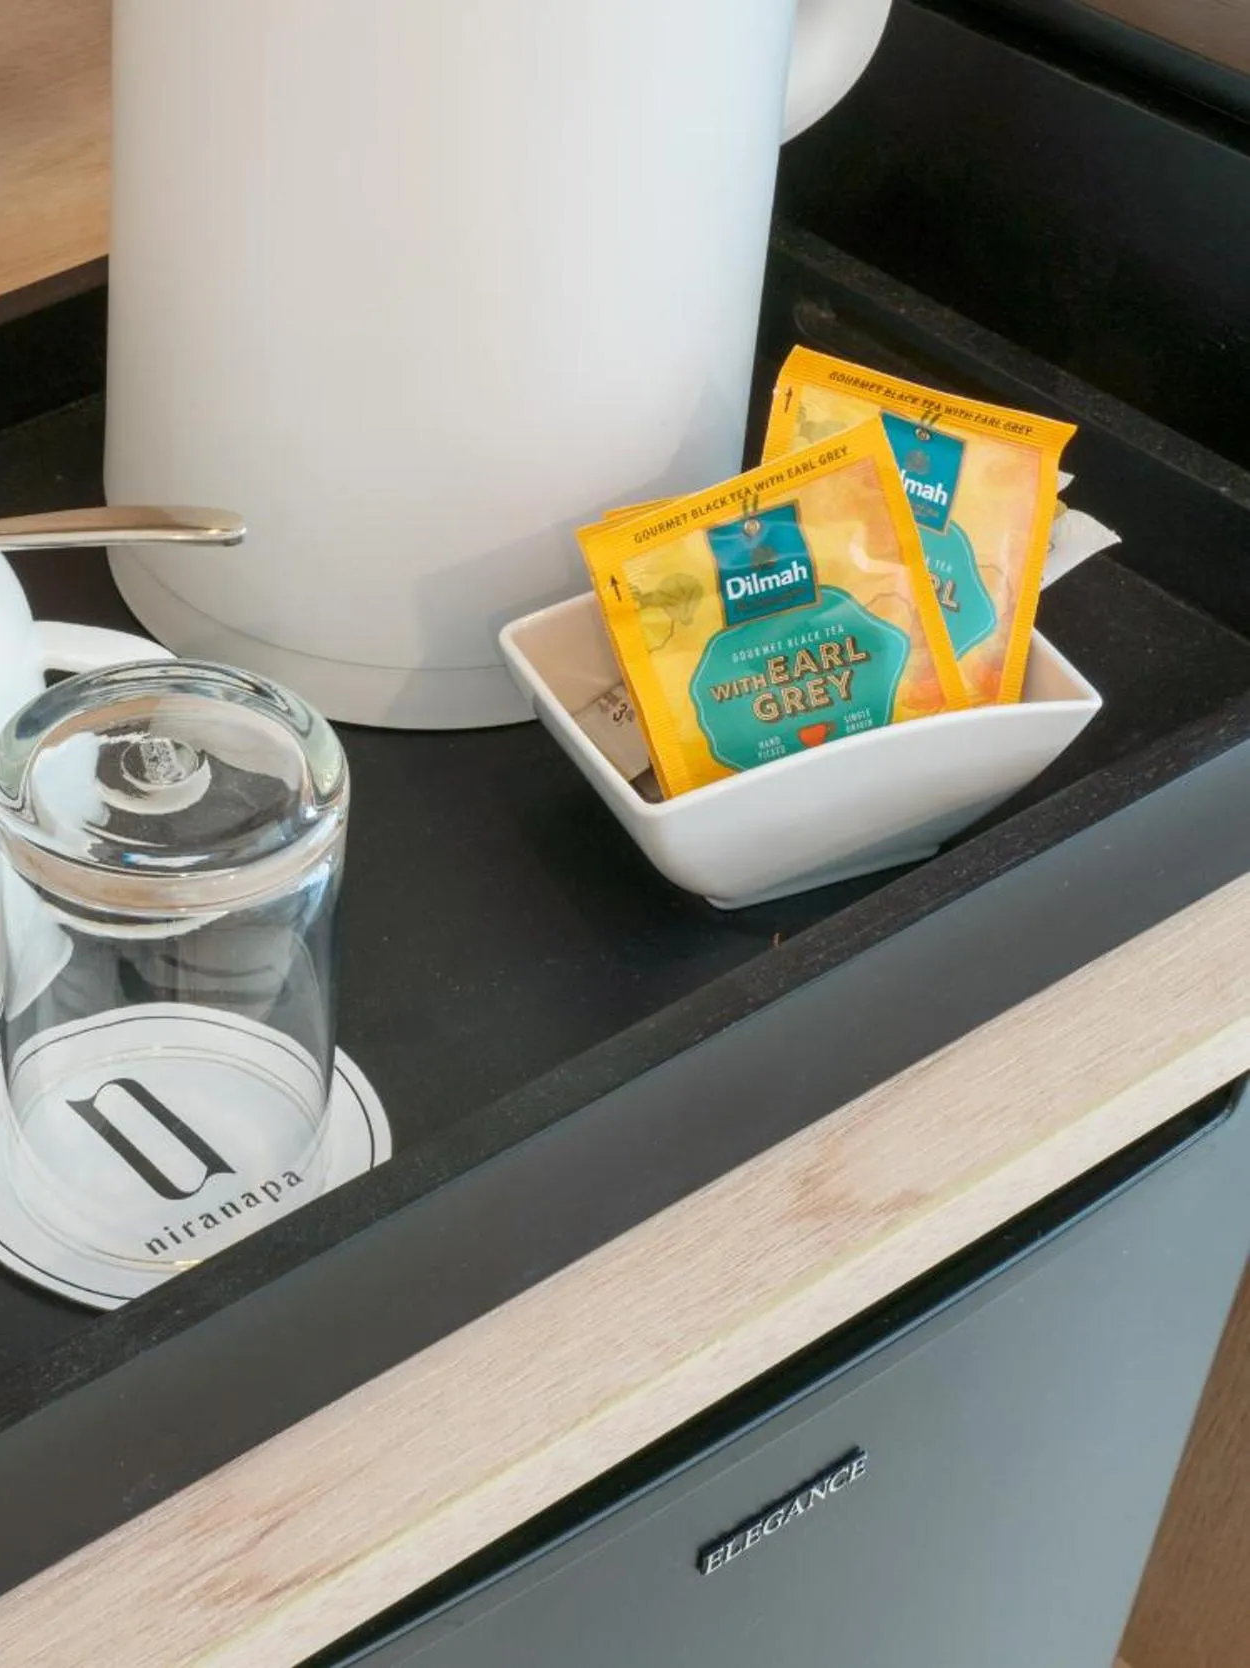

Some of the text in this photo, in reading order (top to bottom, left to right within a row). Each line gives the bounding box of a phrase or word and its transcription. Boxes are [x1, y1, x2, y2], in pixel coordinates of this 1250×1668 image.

[829, 371, 1033, 436] GOURMET BLACK TEA WITH EARL GREY
[633, 446, 849, 544] GOURMET BLACK TEA WITH EARL GREY
[900, 469, 948, 506] lmah
[725, 560, 809, 600] Dilmah
[710, 636, 869, 702] WITH EARL
[732, 624, 845, 664] GOURMET BLACK TEA
[752, 670, 853, 722] GREY
[145, 1170, 303, 1256] niranapa
[703, 1454, 868, 1576] ELEGANCE
